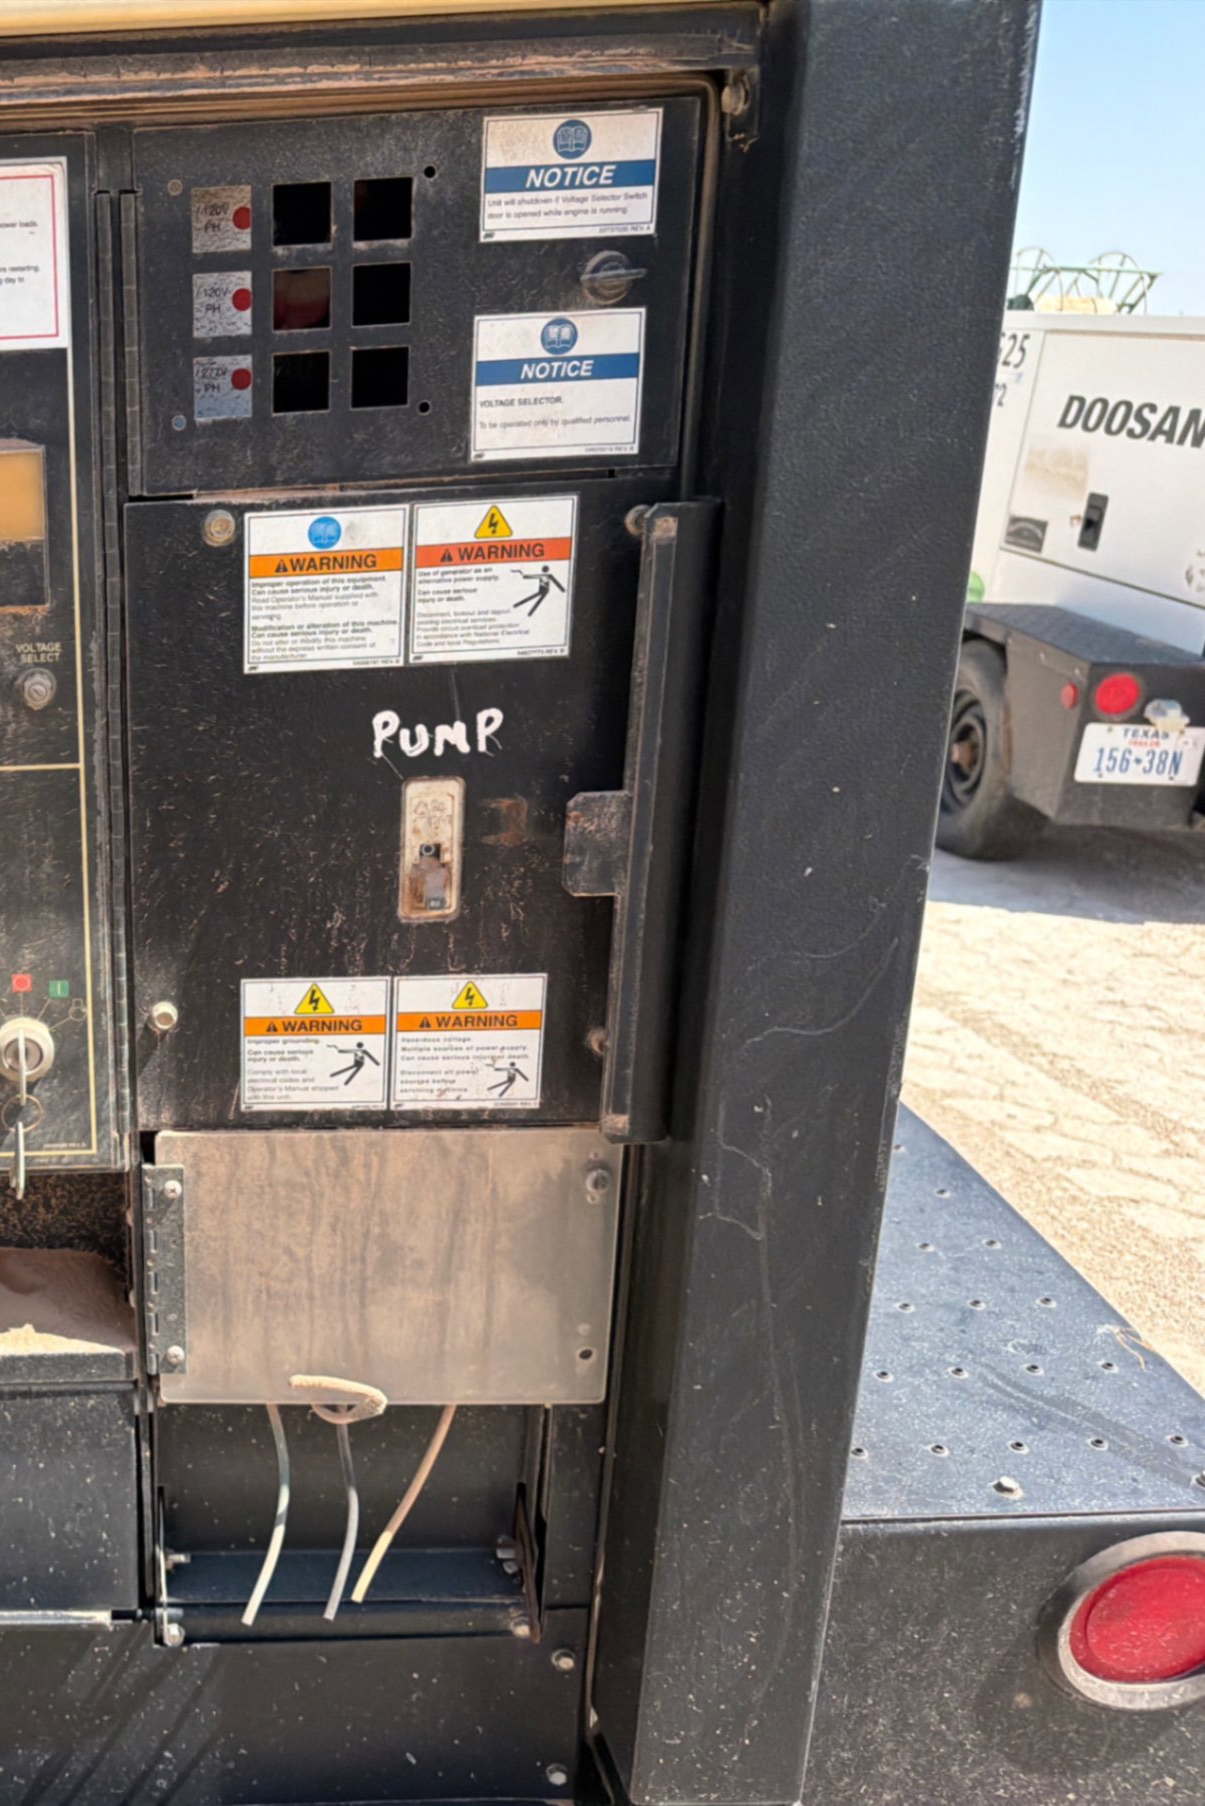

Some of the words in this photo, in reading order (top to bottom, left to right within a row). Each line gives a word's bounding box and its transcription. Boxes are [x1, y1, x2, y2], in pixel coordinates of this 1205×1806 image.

[525, 165, 617, 188] NOTICE
[488, 199, 501, 207] Unit
[504, 198, 515, 206] will
[518, 196, 552, 205] shutdown
[562, 194, 589, 205] Voltage
[592, 193, 621, 201] Selector
[624, 191, 647, 200] Switch
[488, 211, 503, 219] door
[514, 209, 541, 220] opened
[543, 209, 562, 217] while
[565, 207, 589, 218] engine
[592, 207, 597, 215] is
[520, 360, 594, 380] NOTICE
[995, 383, 1007, 407] 2
[480, 399, 514, 408] VOLTAGE
[489, 421, 497, 429] be
[500, 420, 532, 430] operated
[534, 419, 548, 428] only
[550, 418, 559, 427] by
[561, 416, 591, 427] qualified
[1057, 394, 1205, 448] DOOSAN
[458, 543, 545, 561] WARNING
[290, 554, 377, 571] WARNING
[319, 585, 340, 593] injury
[16, 642, 62, 653] VOLTAGE
[20, 652, 61, 664] SELECT
[372, 708, 504, 758] PUMP
[1123, 728, 1169, 739] TEXAS
[282, 1019, 363, 1032] WARNING
[436, 1014, 518, 1028] WARNING
